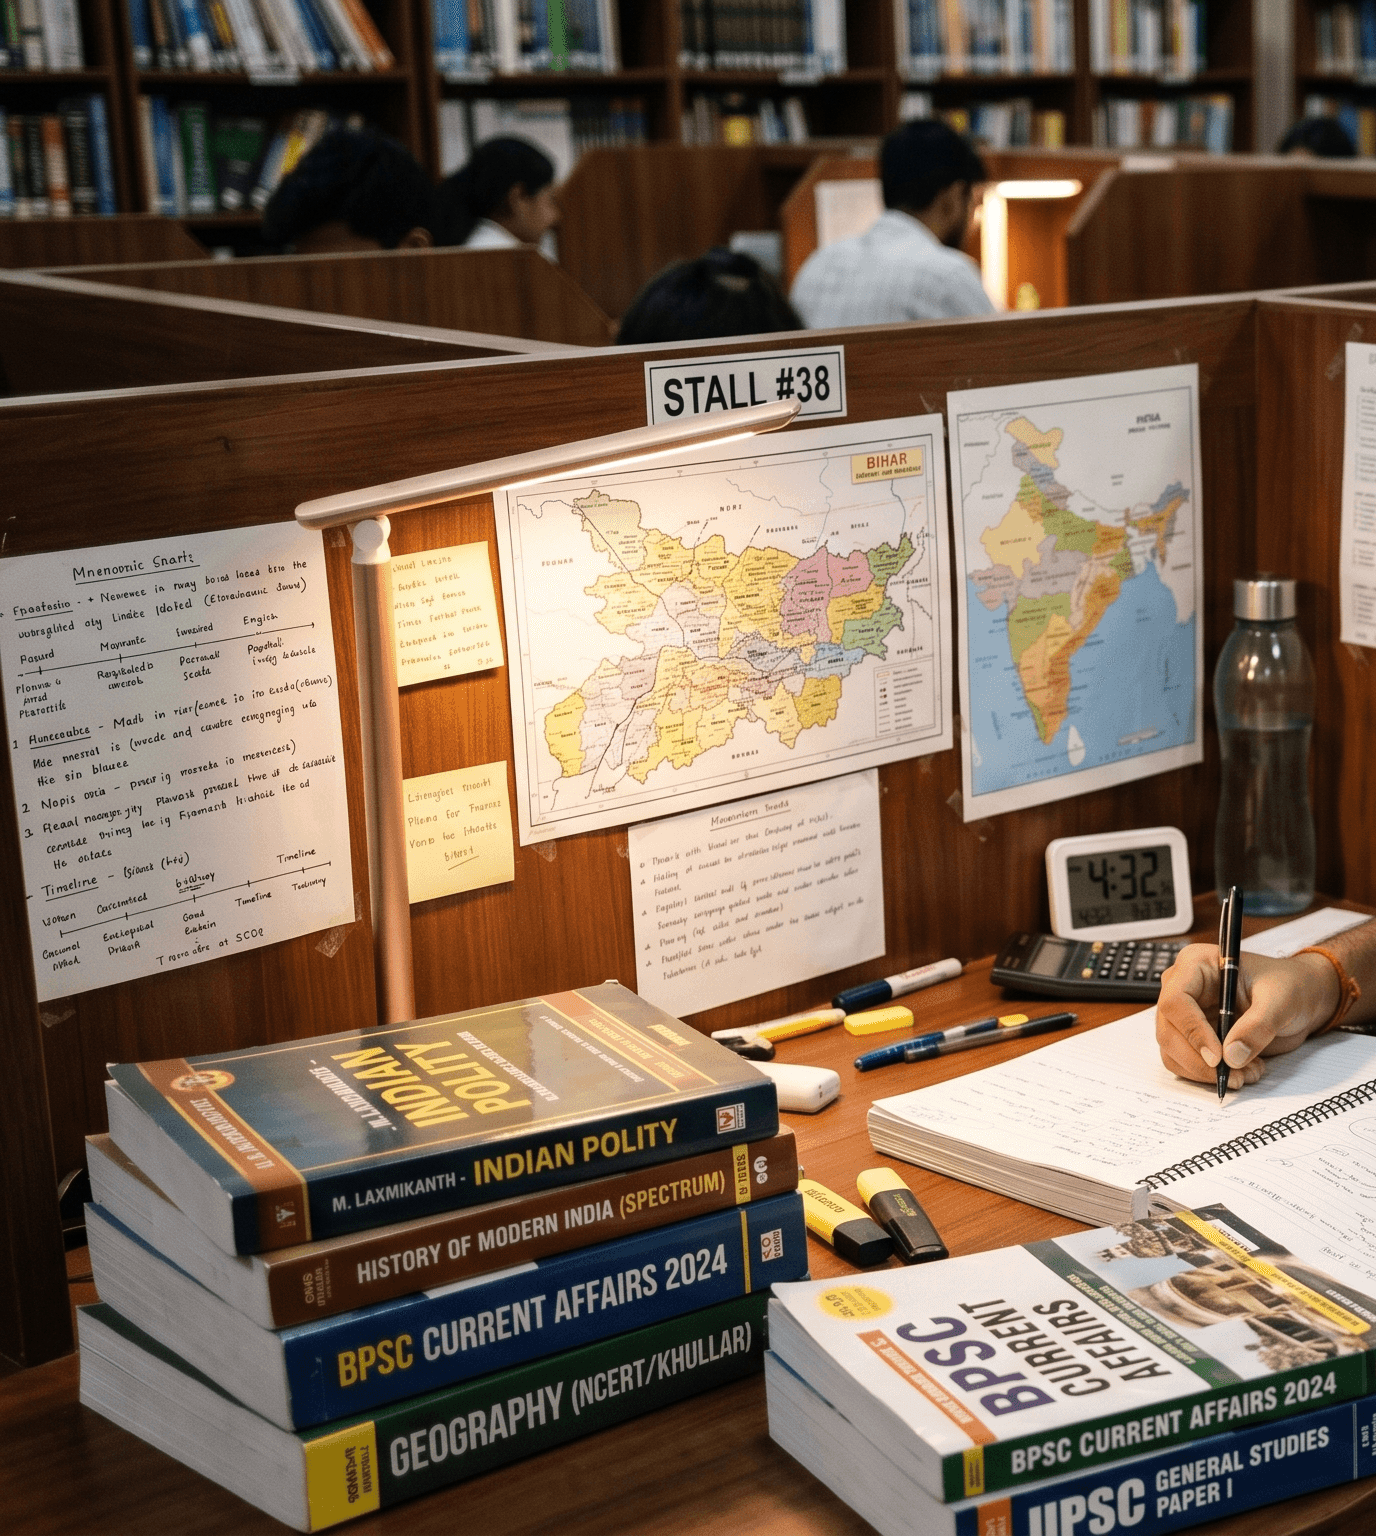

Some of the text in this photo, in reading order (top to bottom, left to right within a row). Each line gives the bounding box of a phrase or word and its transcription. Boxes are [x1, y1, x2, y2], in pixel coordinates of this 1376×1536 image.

[664, 365, 830, 416] STALL #38
[867, 453, 907, 469] BIHAR
[173, 726, 192, 739] and
[331, 1046, 470, 1128] INDIAN
[394, 1041, 533, 1114] POLITY
[333, 1196, 352, 1213] M.
[355, 1172, 457, 1208] LAXMIKANTH
[474, 1141, 574, 1186] INDIAN
[582, 1118, 679, 1162] POLITY
[357, 1243, 442, 1284] HISTORY
[448, 1235, 471, 1260] OF
[478, 1212, 559, 1251] MODERN
[564, 1199, 615, 1231] INDIA
[619, 1169, 726, 1220] (SPECTRUM)
[337, 1244, 728, 1388] BPSC CURRENT AFFAIRS 2024
[957, 1298, 1111, 1397] CURRENT
[1031, 1299, 1173, 1382] AFFAIRS
[389, 1381, 565, 1478] GEOGRAPHY
[570, 1321, 752, 1416] (NCERT/KHULLAR)
[896, 1316, 1057, 1417] BPSC
[1011, 1371, 1338, 1475] BPSC CURRENT AFFAIRS 2024
[1155, 1444, 1244, 1494] GENERAL
[1249, 1426, 1330, 1465] STUDIES
[1155, 1479, 1233, 1518] PAPER I
